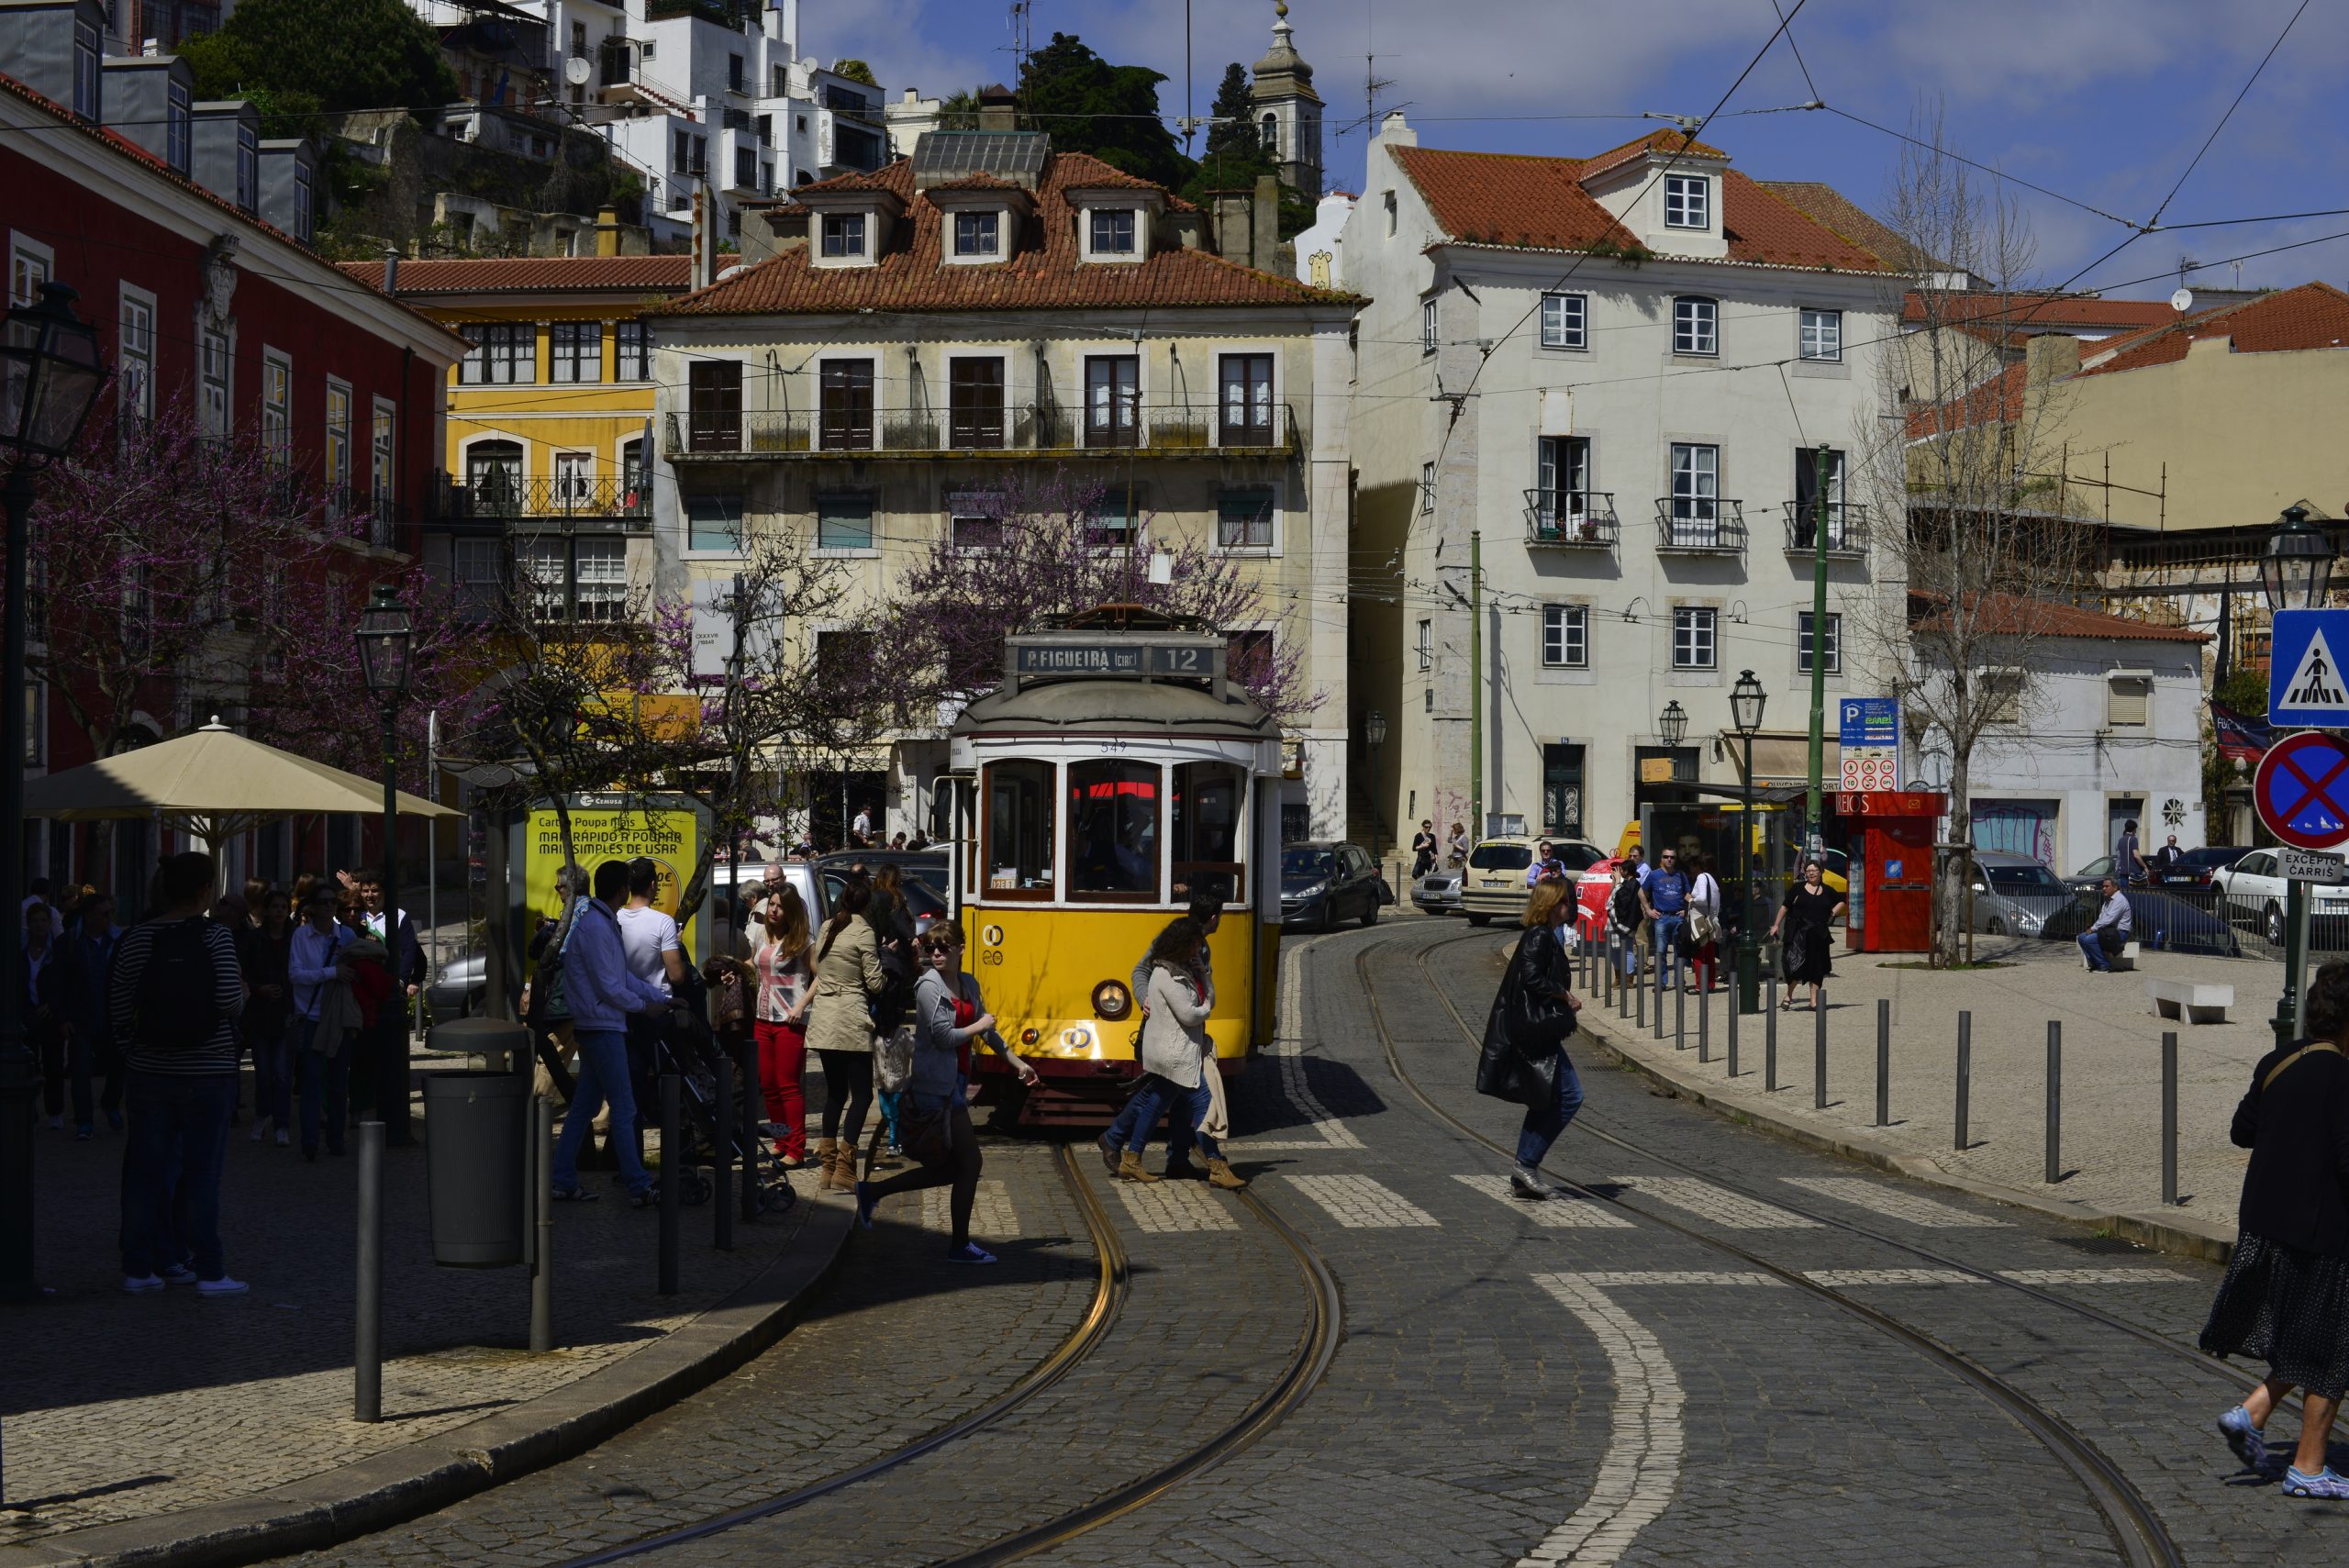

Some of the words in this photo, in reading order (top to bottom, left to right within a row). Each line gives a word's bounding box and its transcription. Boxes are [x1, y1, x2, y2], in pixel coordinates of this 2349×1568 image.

[1166, 649, 1198, 671] 12
[1865, 713, 1894, 725] emel
[1100, 740, 1128, 753] 549
[574, 817, 607, 828] Poupa
[573, 828, 618, 842] RÁPIDO
[632, 831, 682, 843] POUPAR
[572, 843, 623, 855] SIMPLES
[626, 844, 641, 855] DE
[645, 844, 678, 855] USAR
[2286, 853, 2338, 866] EXCEPTO
[2288, 865, 2333, 877] CARRIS
